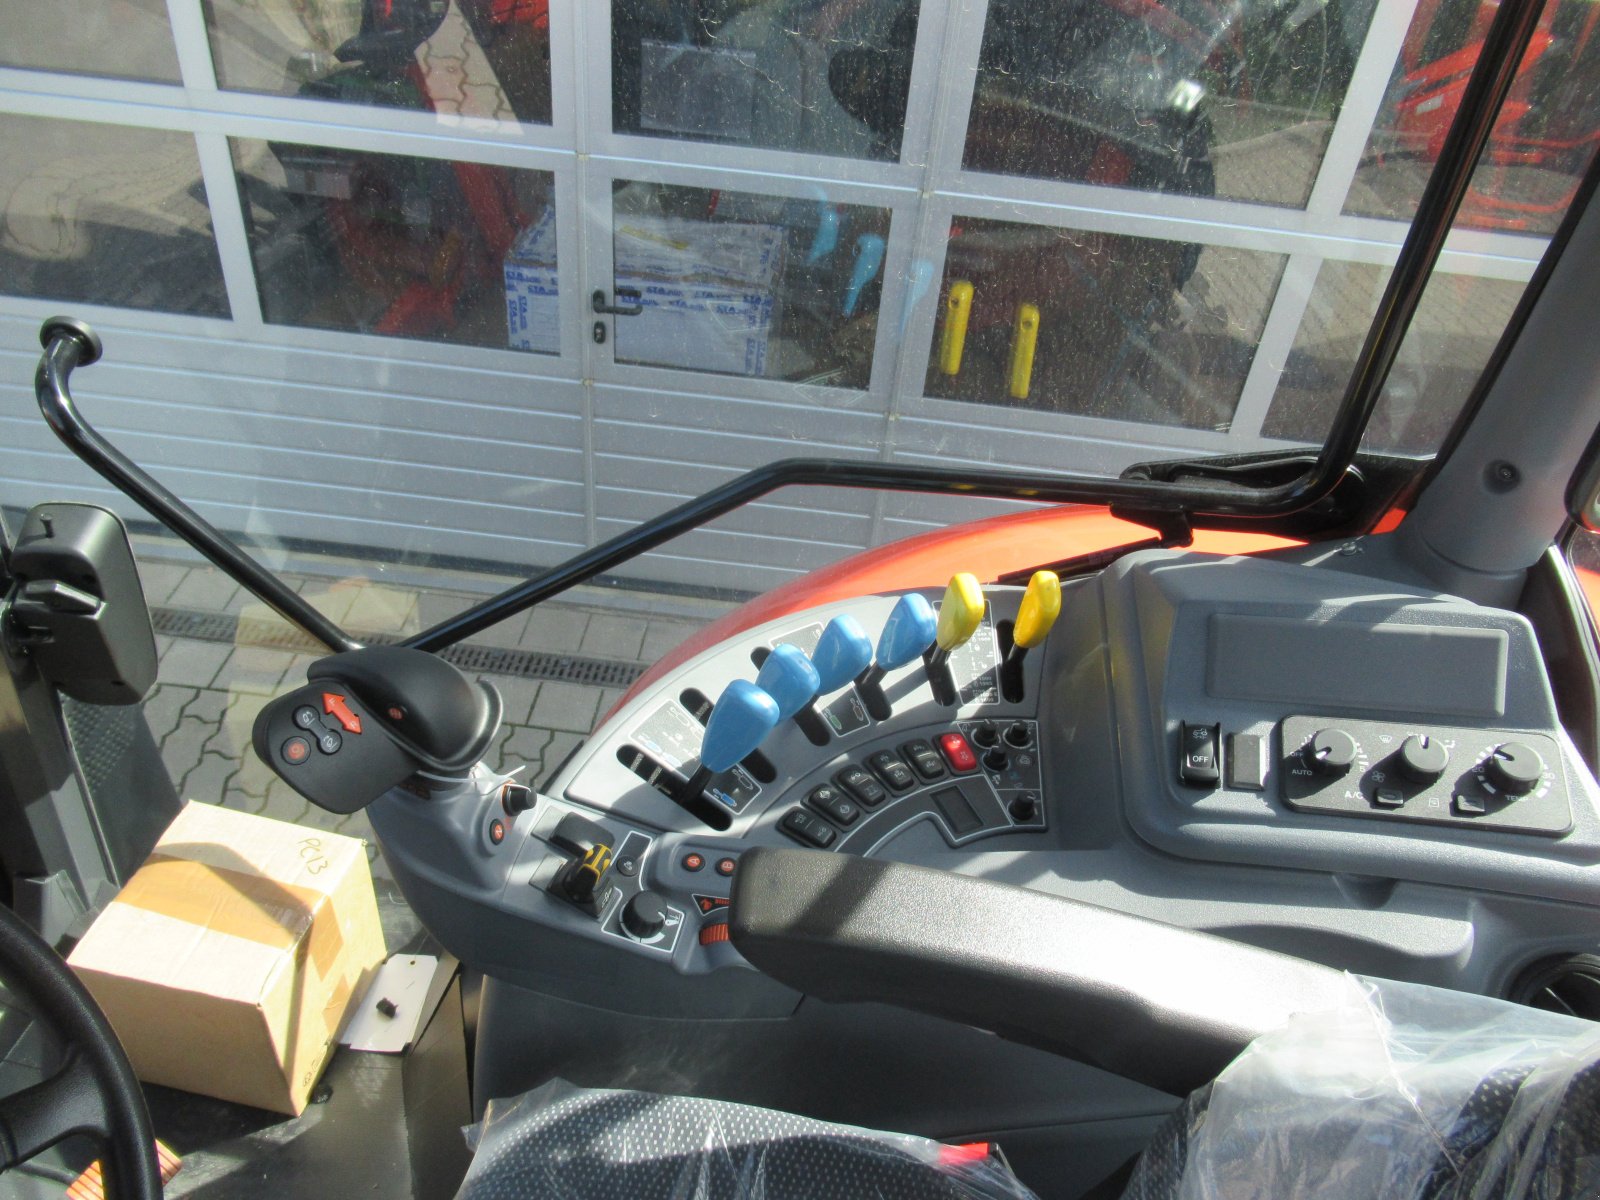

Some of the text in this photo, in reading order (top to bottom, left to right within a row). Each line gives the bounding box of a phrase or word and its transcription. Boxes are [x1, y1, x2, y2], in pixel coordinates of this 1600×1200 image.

[1192, 755, 1209, 763] OFF
[1291, 768, 1313, 776] AUTO
[1344, 790, 1364, 800] A/C
